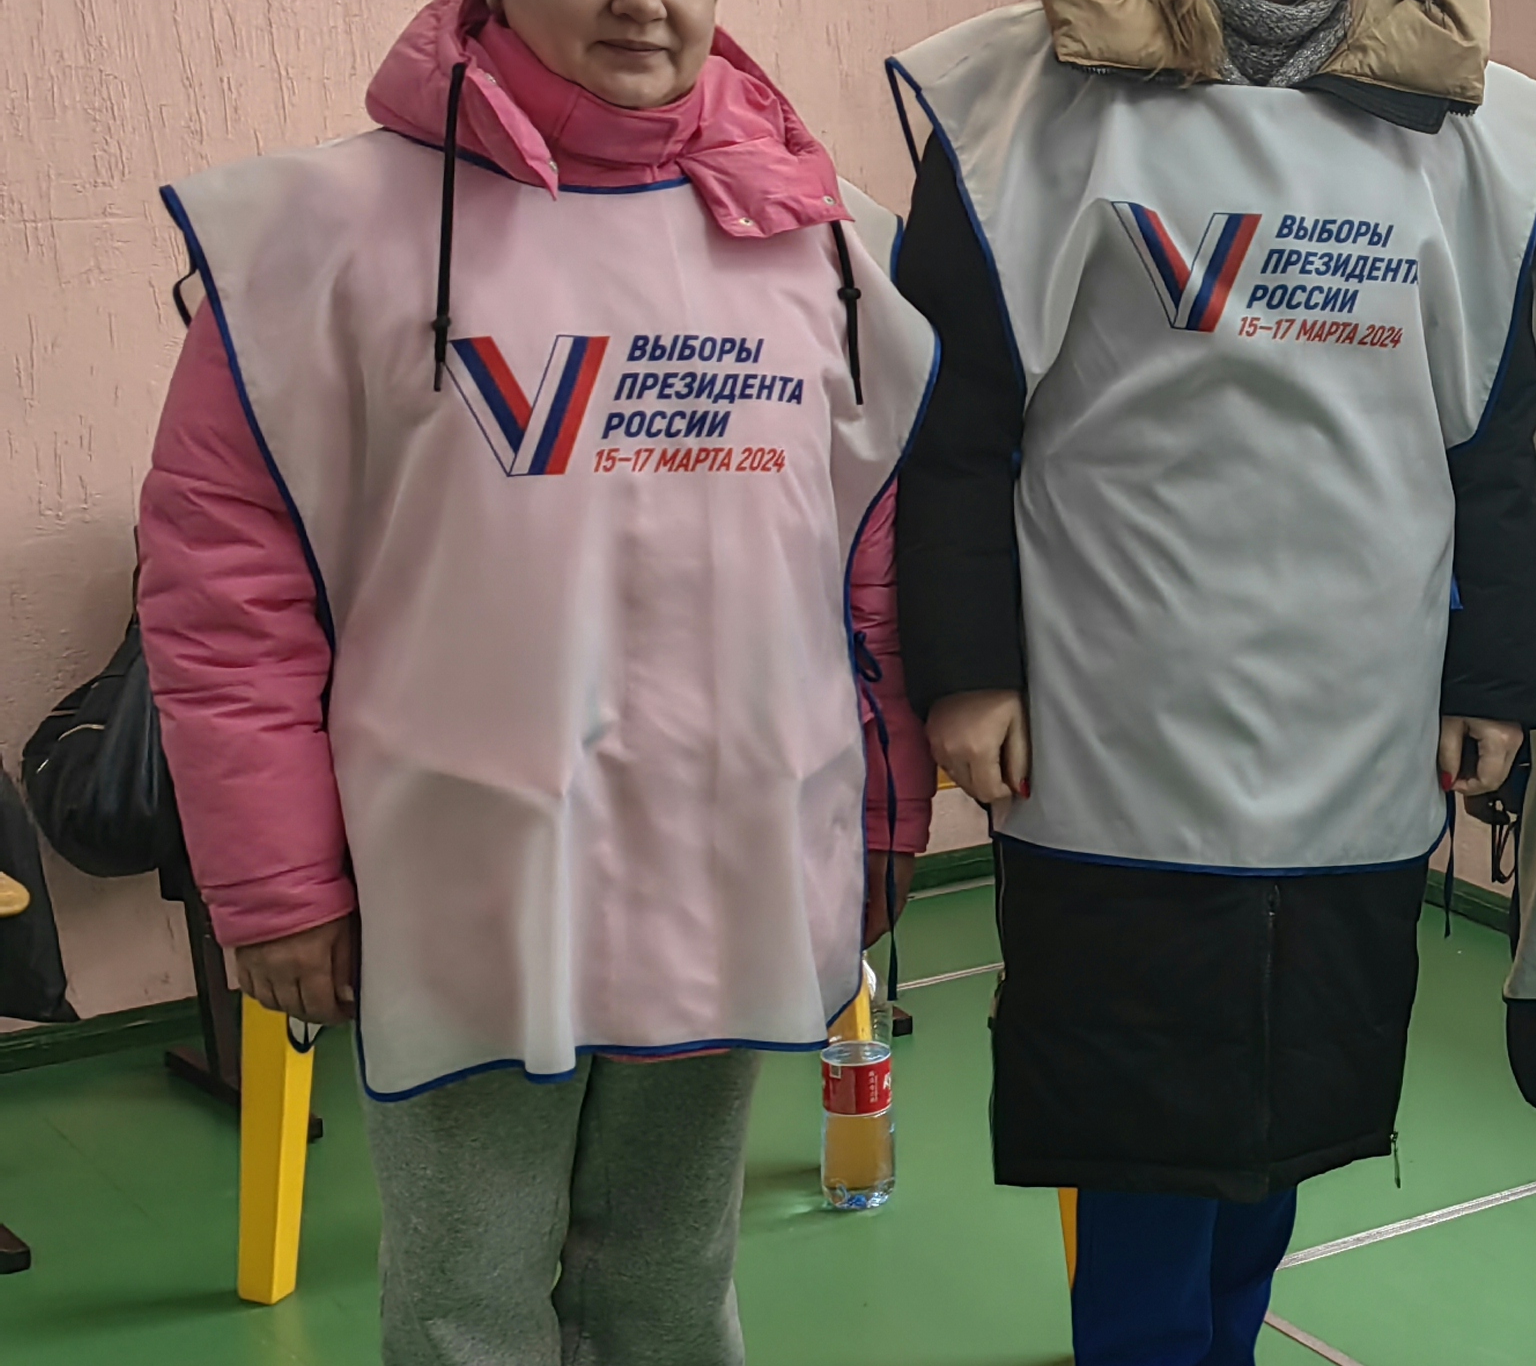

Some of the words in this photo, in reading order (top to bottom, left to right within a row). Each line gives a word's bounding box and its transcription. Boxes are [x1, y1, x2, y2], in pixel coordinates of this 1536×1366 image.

[1275, 214, 1394, 248] ВЫБОРЫ
[1246, 284, 1358, 313] РОССИИ
[1296, 319, 1359, 346] МАРТА
[1357, 325, 1403, 349] 2024
[627, 335, 764, 364] ВЫБОРЫ
[613, 372, 804, 406] ПРЕЗИДЕНТА
[602, 410, 731, 439] РОССИИ
[654, 448, 733, 473] МАРТА
[735, 448, 786, 473] 2024
